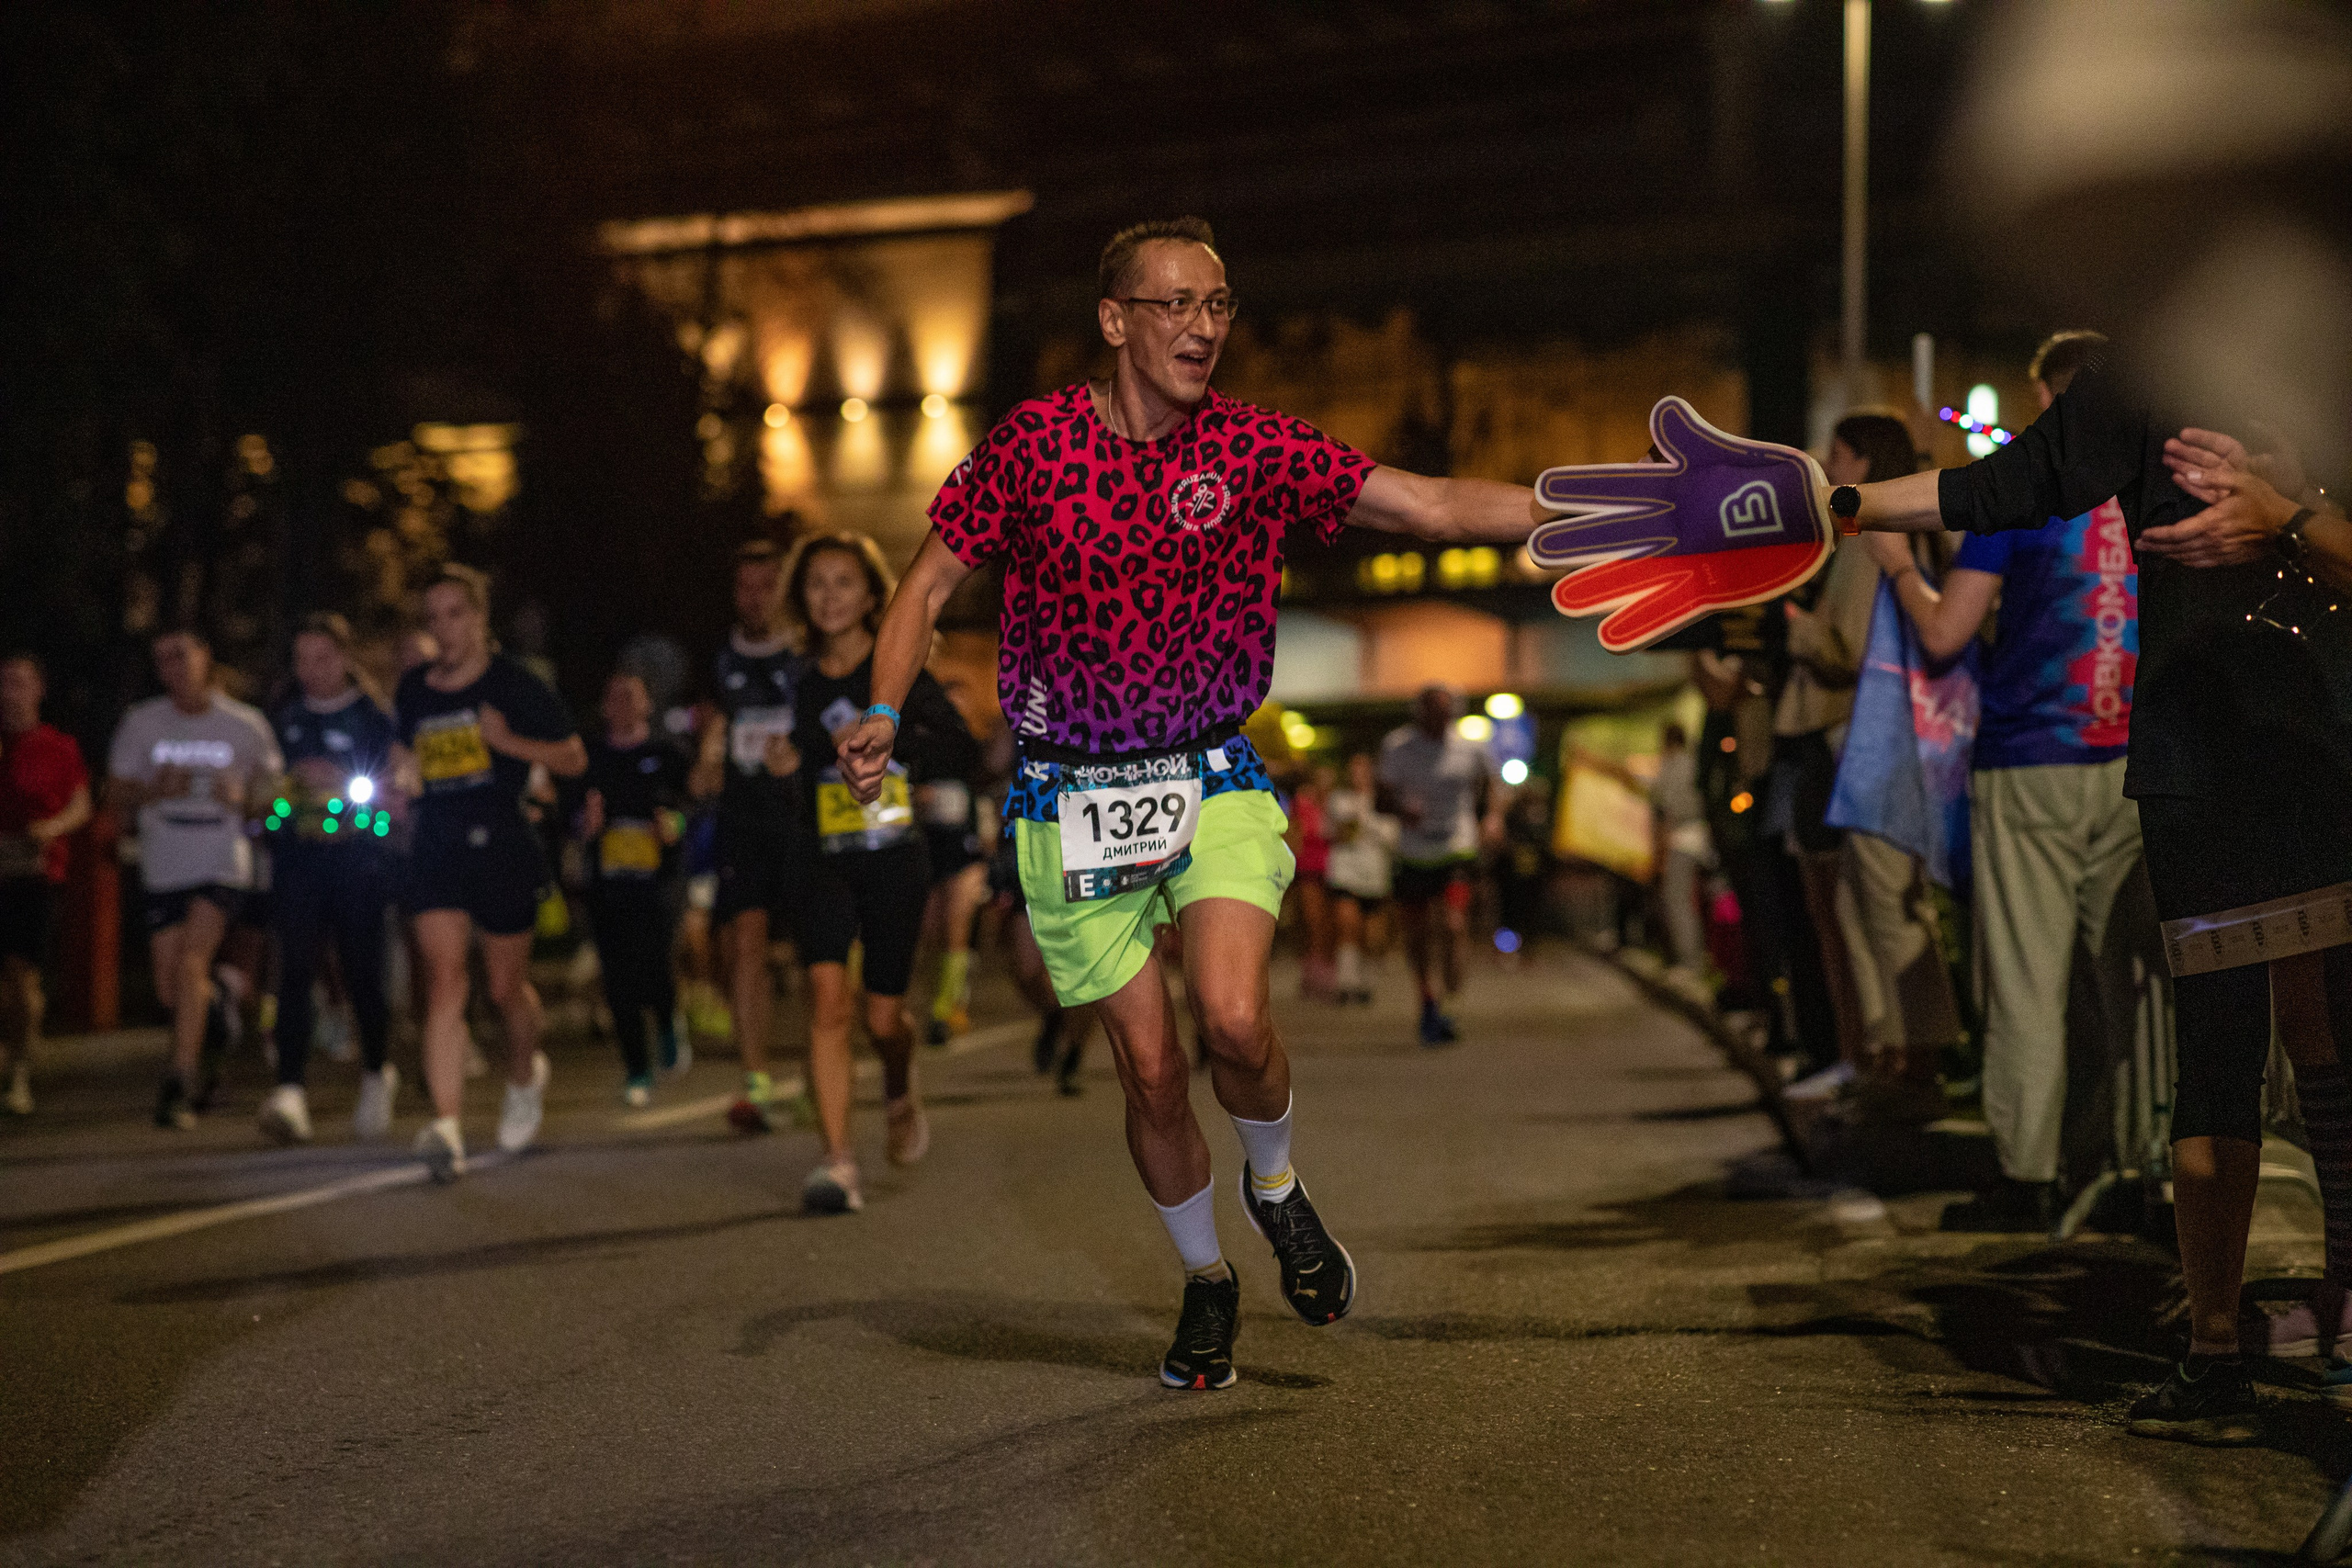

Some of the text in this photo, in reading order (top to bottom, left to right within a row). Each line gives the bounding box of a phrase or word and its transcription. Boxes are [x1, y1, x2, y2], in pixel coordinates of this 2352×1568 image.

[1082, 793, 1186, 842] 1329
[1102, 837, 1167, 861] ДМИТРИЙ
[1080, 874, 1096, 897] E
